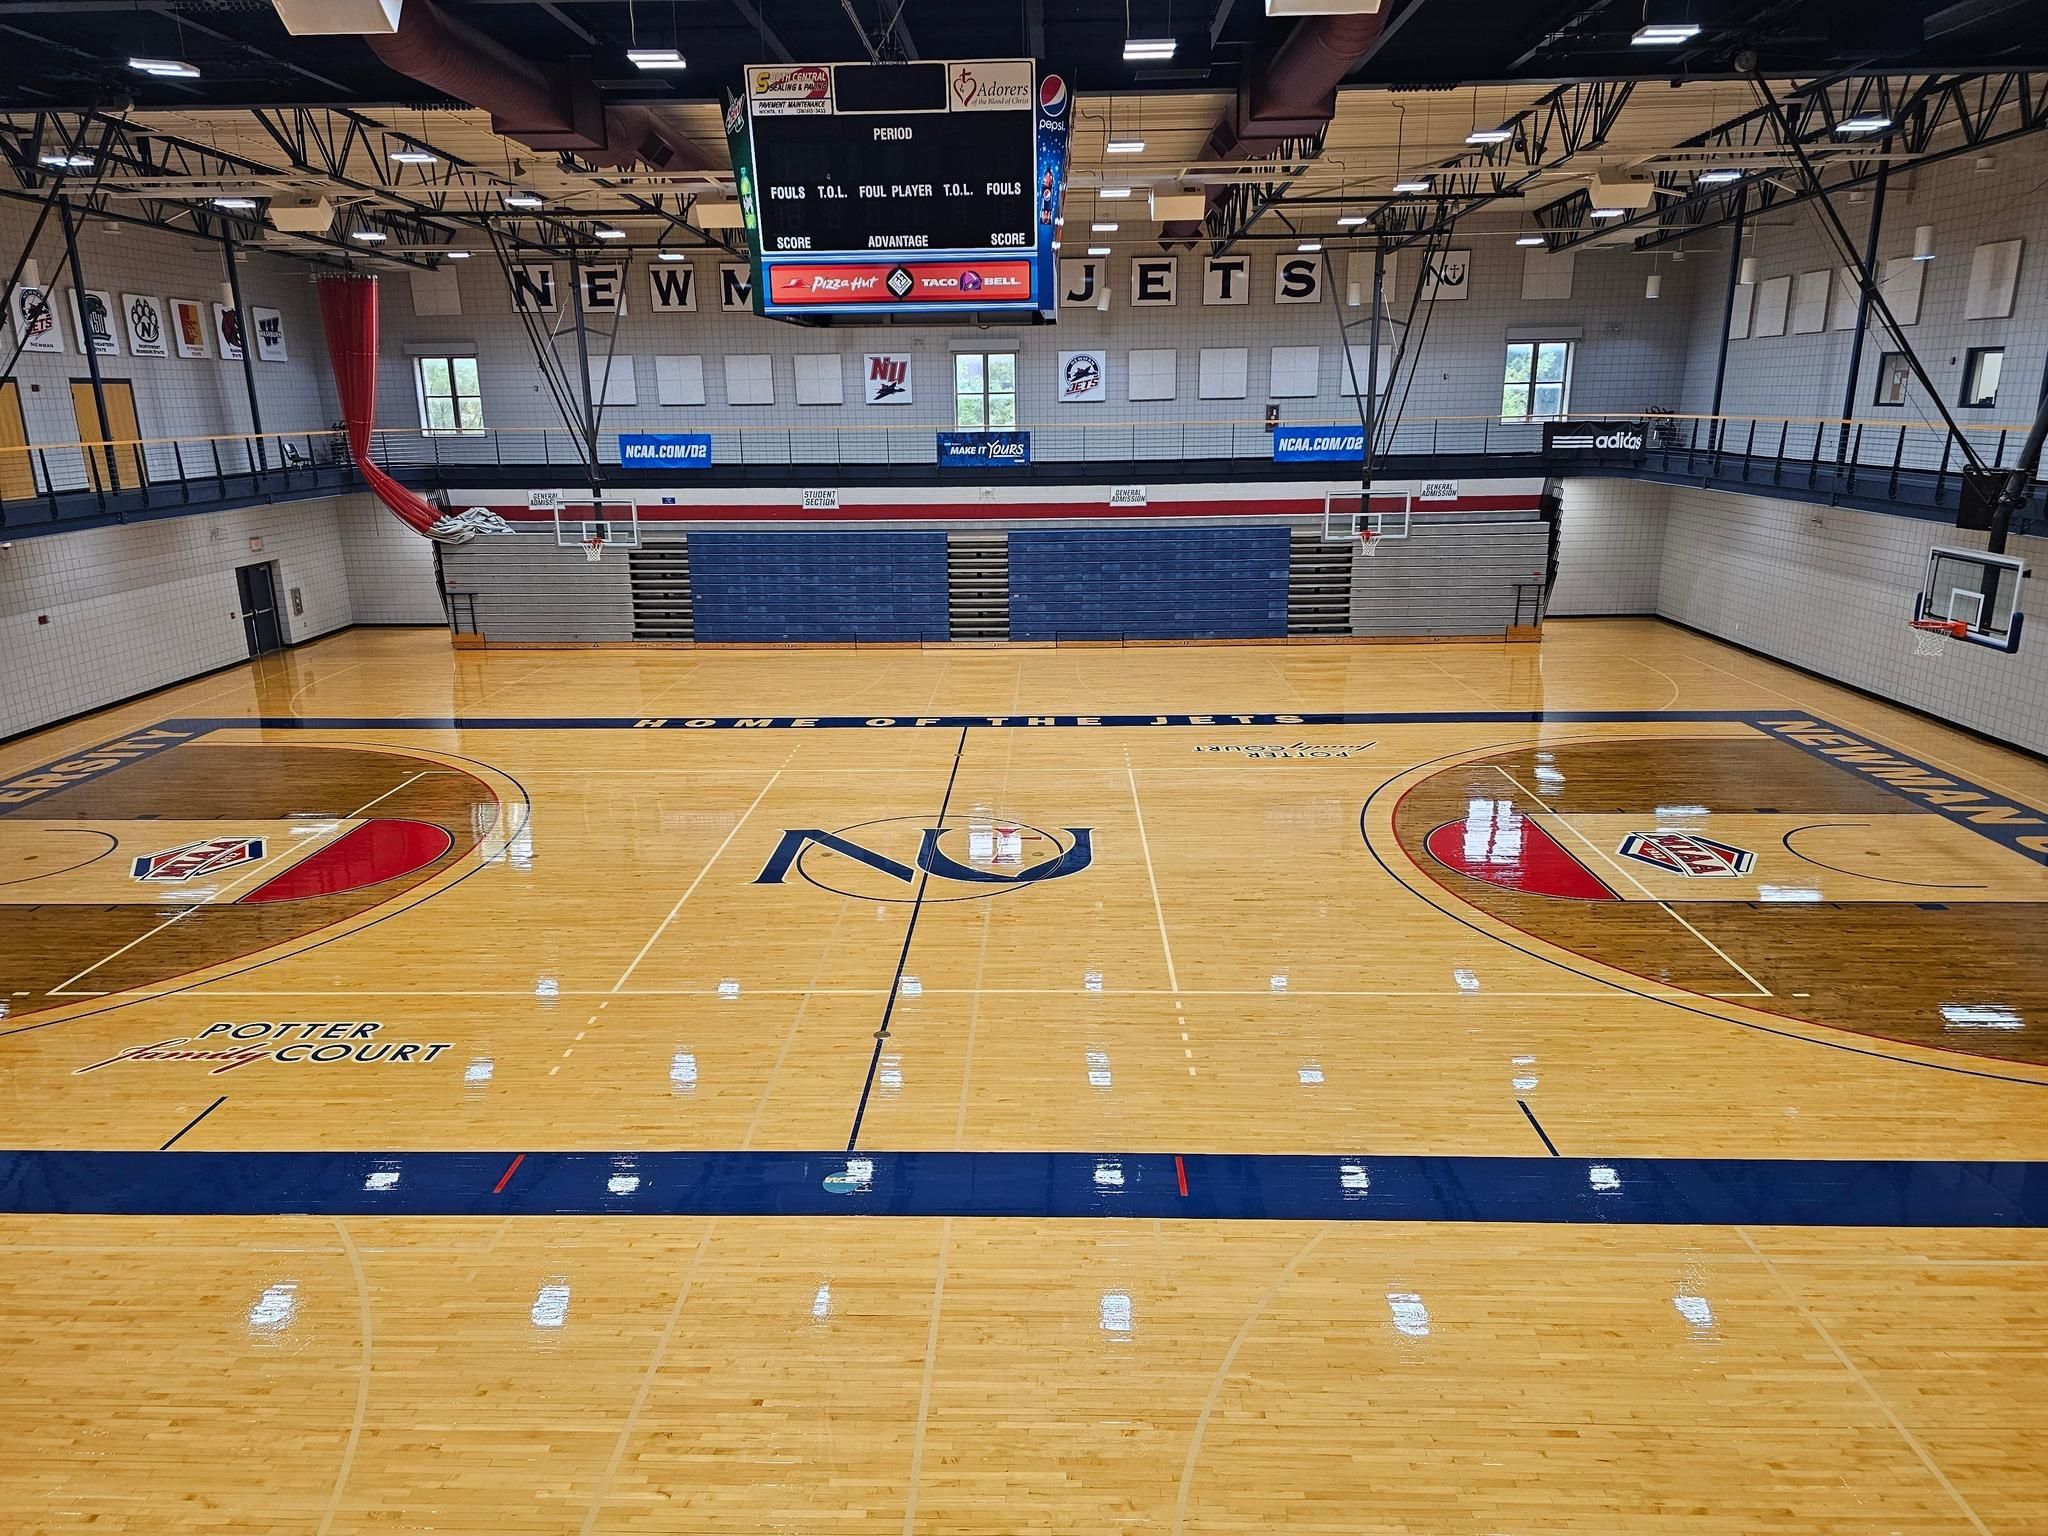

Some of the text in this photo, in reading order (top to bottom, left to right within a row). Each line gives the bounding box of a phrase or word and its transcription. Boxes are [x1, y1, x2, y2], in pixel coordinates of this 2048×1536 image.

[792, 72, 826, 82] CENTRAL
[769, 83, 797, 92] SEALING
[804, 82, 827, 91] PAVING
[977, 82, 1029, 97] Adorers
[758, 100, 826, 109] PAVEMENT MAINTENANCE
[989, 97, 1004, 105] Blood
[1004, 97, 1012, 105] of
[1012, 96, 1029, 105] Christ
[873, 127, 913, 141] PERIOD
[770, 186, 806, 200] FOULS
[817, 185, 848, 199] T.O.L.
[859, 184, 933, 198] FOUL PLAYER
[943, 183, 974, 196] T.O.L.
[986, 182, 1021, 196] FOULS
[776, 236, 812, 250] SCORE
[868, 235, 929, 248] ADVANTAGE
[990, 232, 1026, 246] SCORE
[811, 275, 850, 291] Pizza
[850, 275, 879, 291] Hut
[921, 277, 1018, 287] TACO BELL
[141, 321, 152, 338] N
[870, 357, 908, 383] NU
[1066, 377, 1100, 393] JETS
[1278, 436, 1364, 452] NCAA.COM/D2
[1595, 431, 1643, 450] adidas
[625, 444, 708, 459] NCAA.COM/D2
[950, 439, 1025, 458] MAKE IT YOURS
[804, 490, 836, 499] STUDENT
[1111, 495, 1146, 503] ADMISSION
[805, 498, 836, 506] SECTION
[632, 715, 1305, 728] HOME OF THE JETS
[1246, 751, 1349, 759] POTTER
[1757, 720, 2047, 825] NEWMAN
[744, 828, 1095, 884] NU
[199, 1022, 381, 1040] POTTER
[74, 1038, 454, 1075] family COURT
